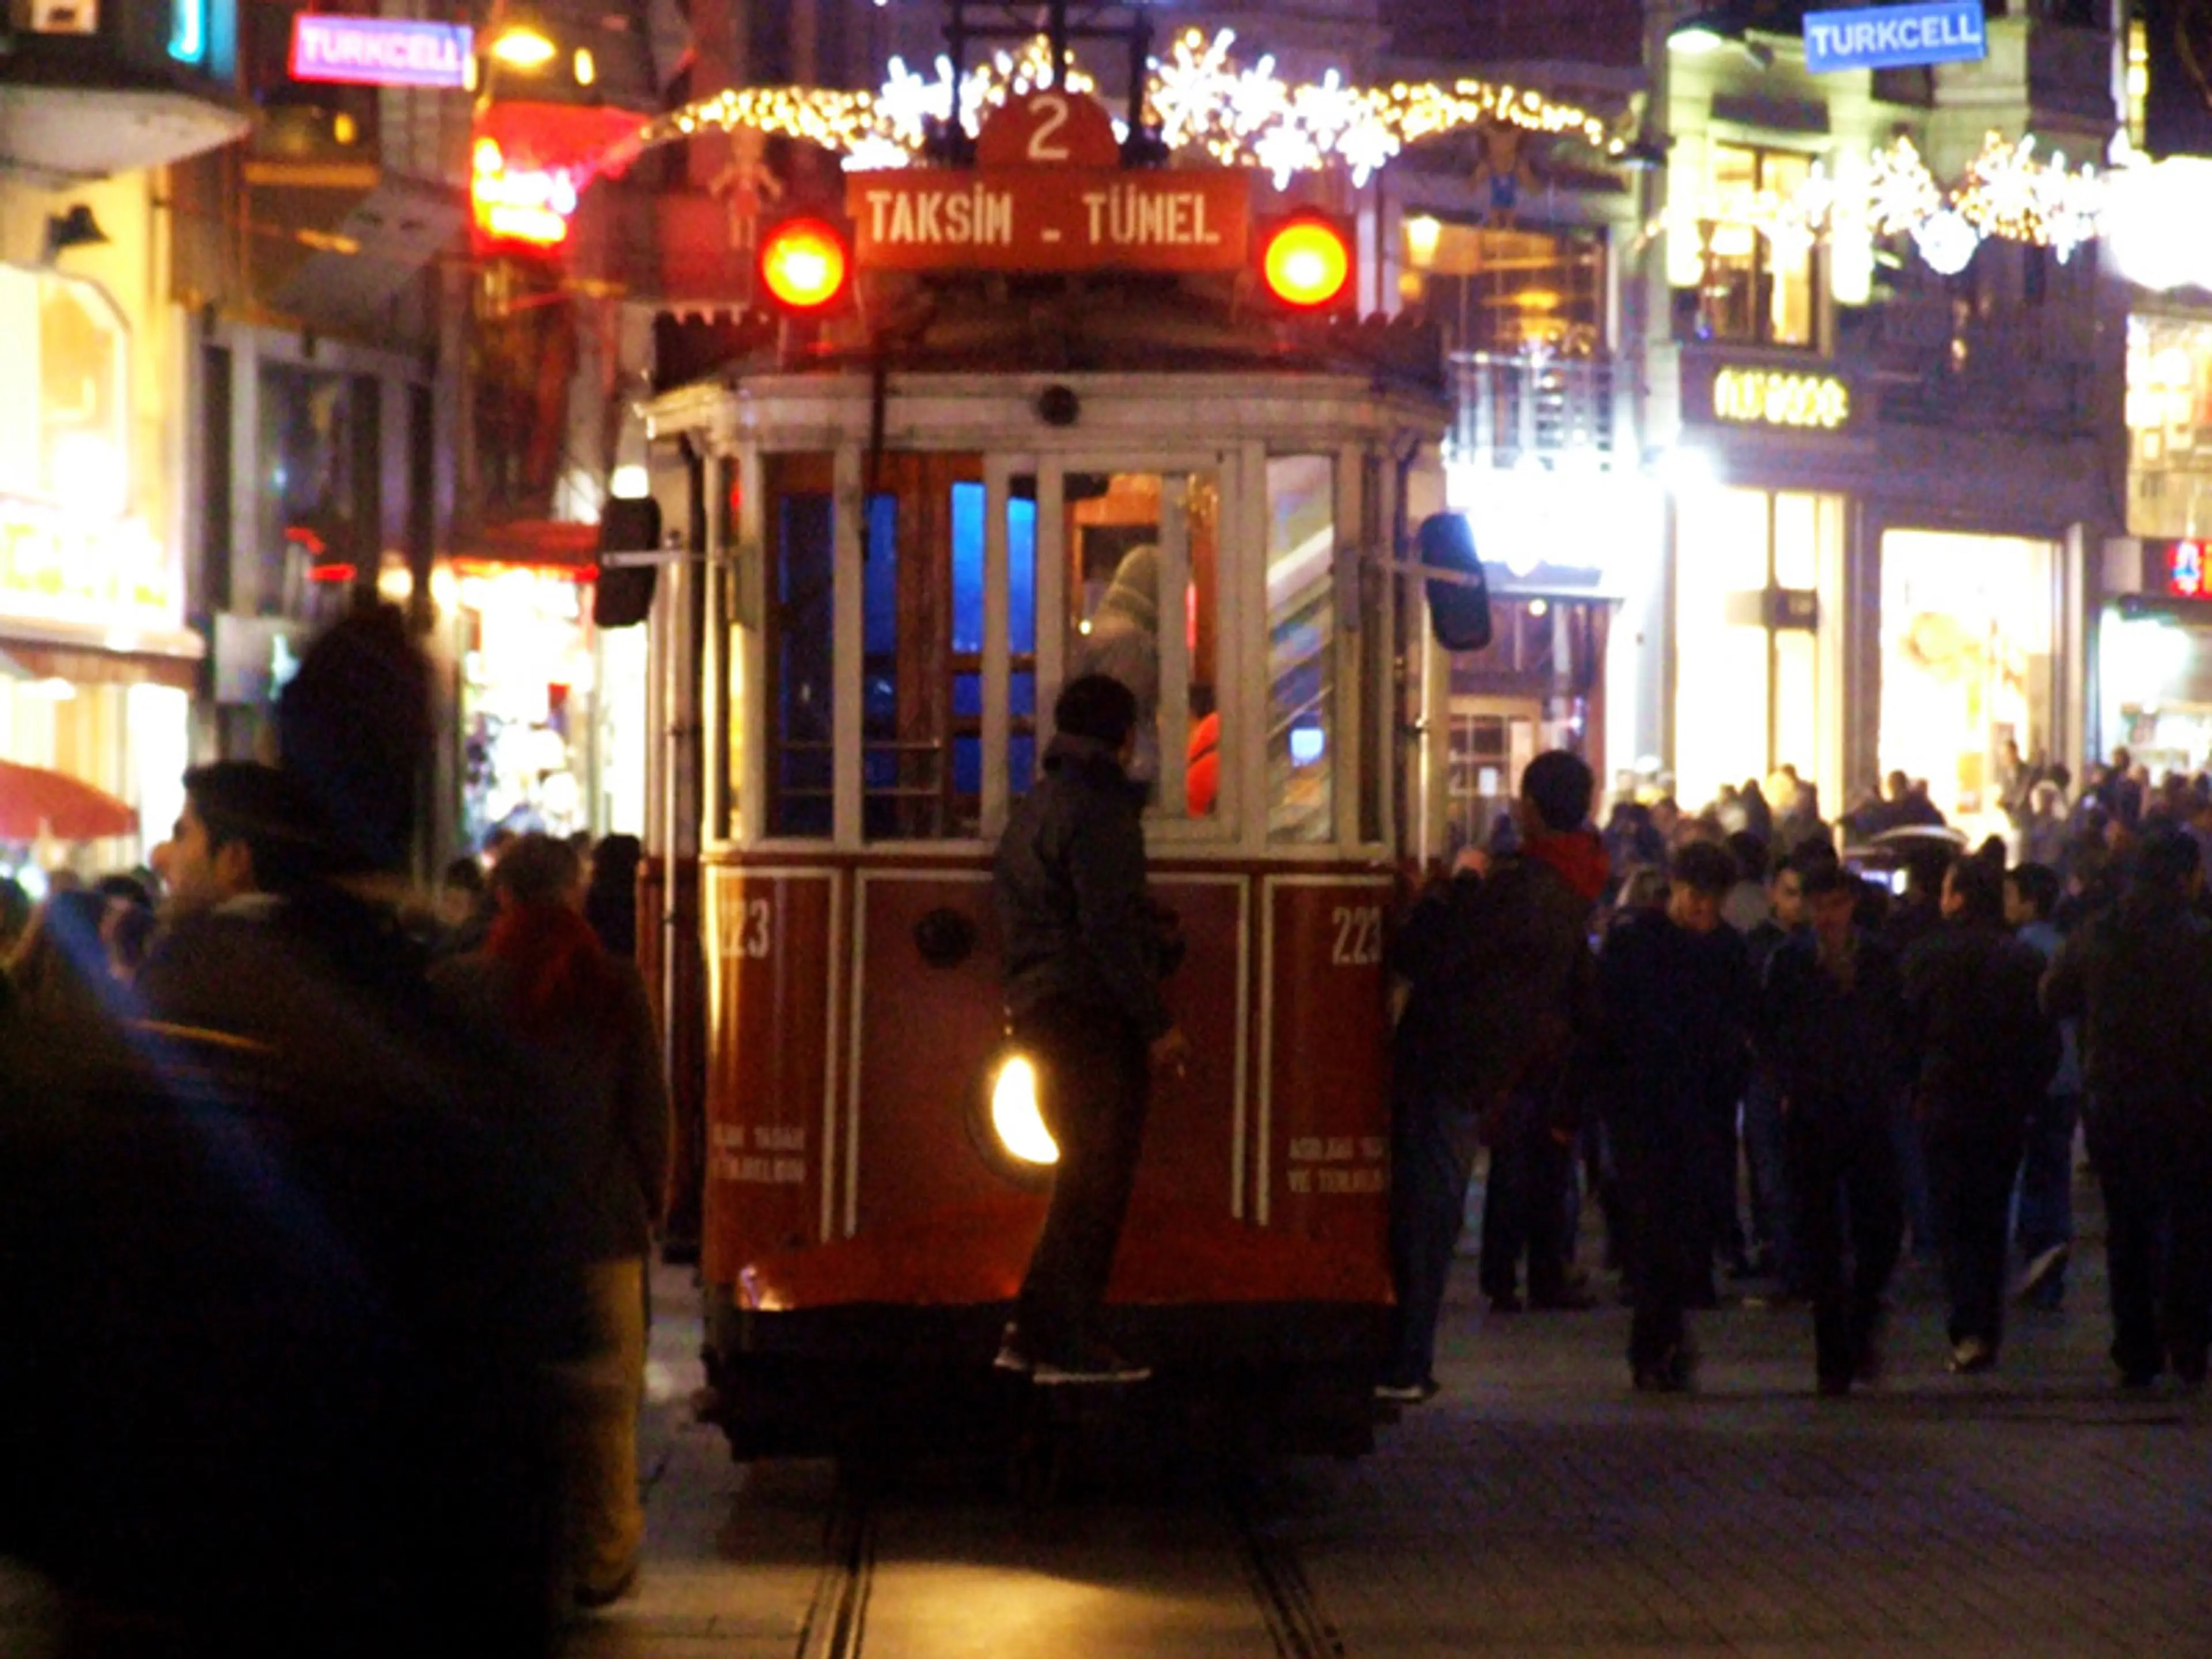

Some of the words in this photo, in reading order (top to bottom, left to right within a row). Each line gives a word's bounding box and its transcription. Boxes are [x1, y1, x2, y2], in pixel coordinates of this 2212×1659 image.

[302, 28, 459, 72] TURKCELL
[1809, 14, 1980, 56] TURKCELL
[1028, 95, 1069, 159] 2
[867, 185, 1012, 245] TAKSİM
